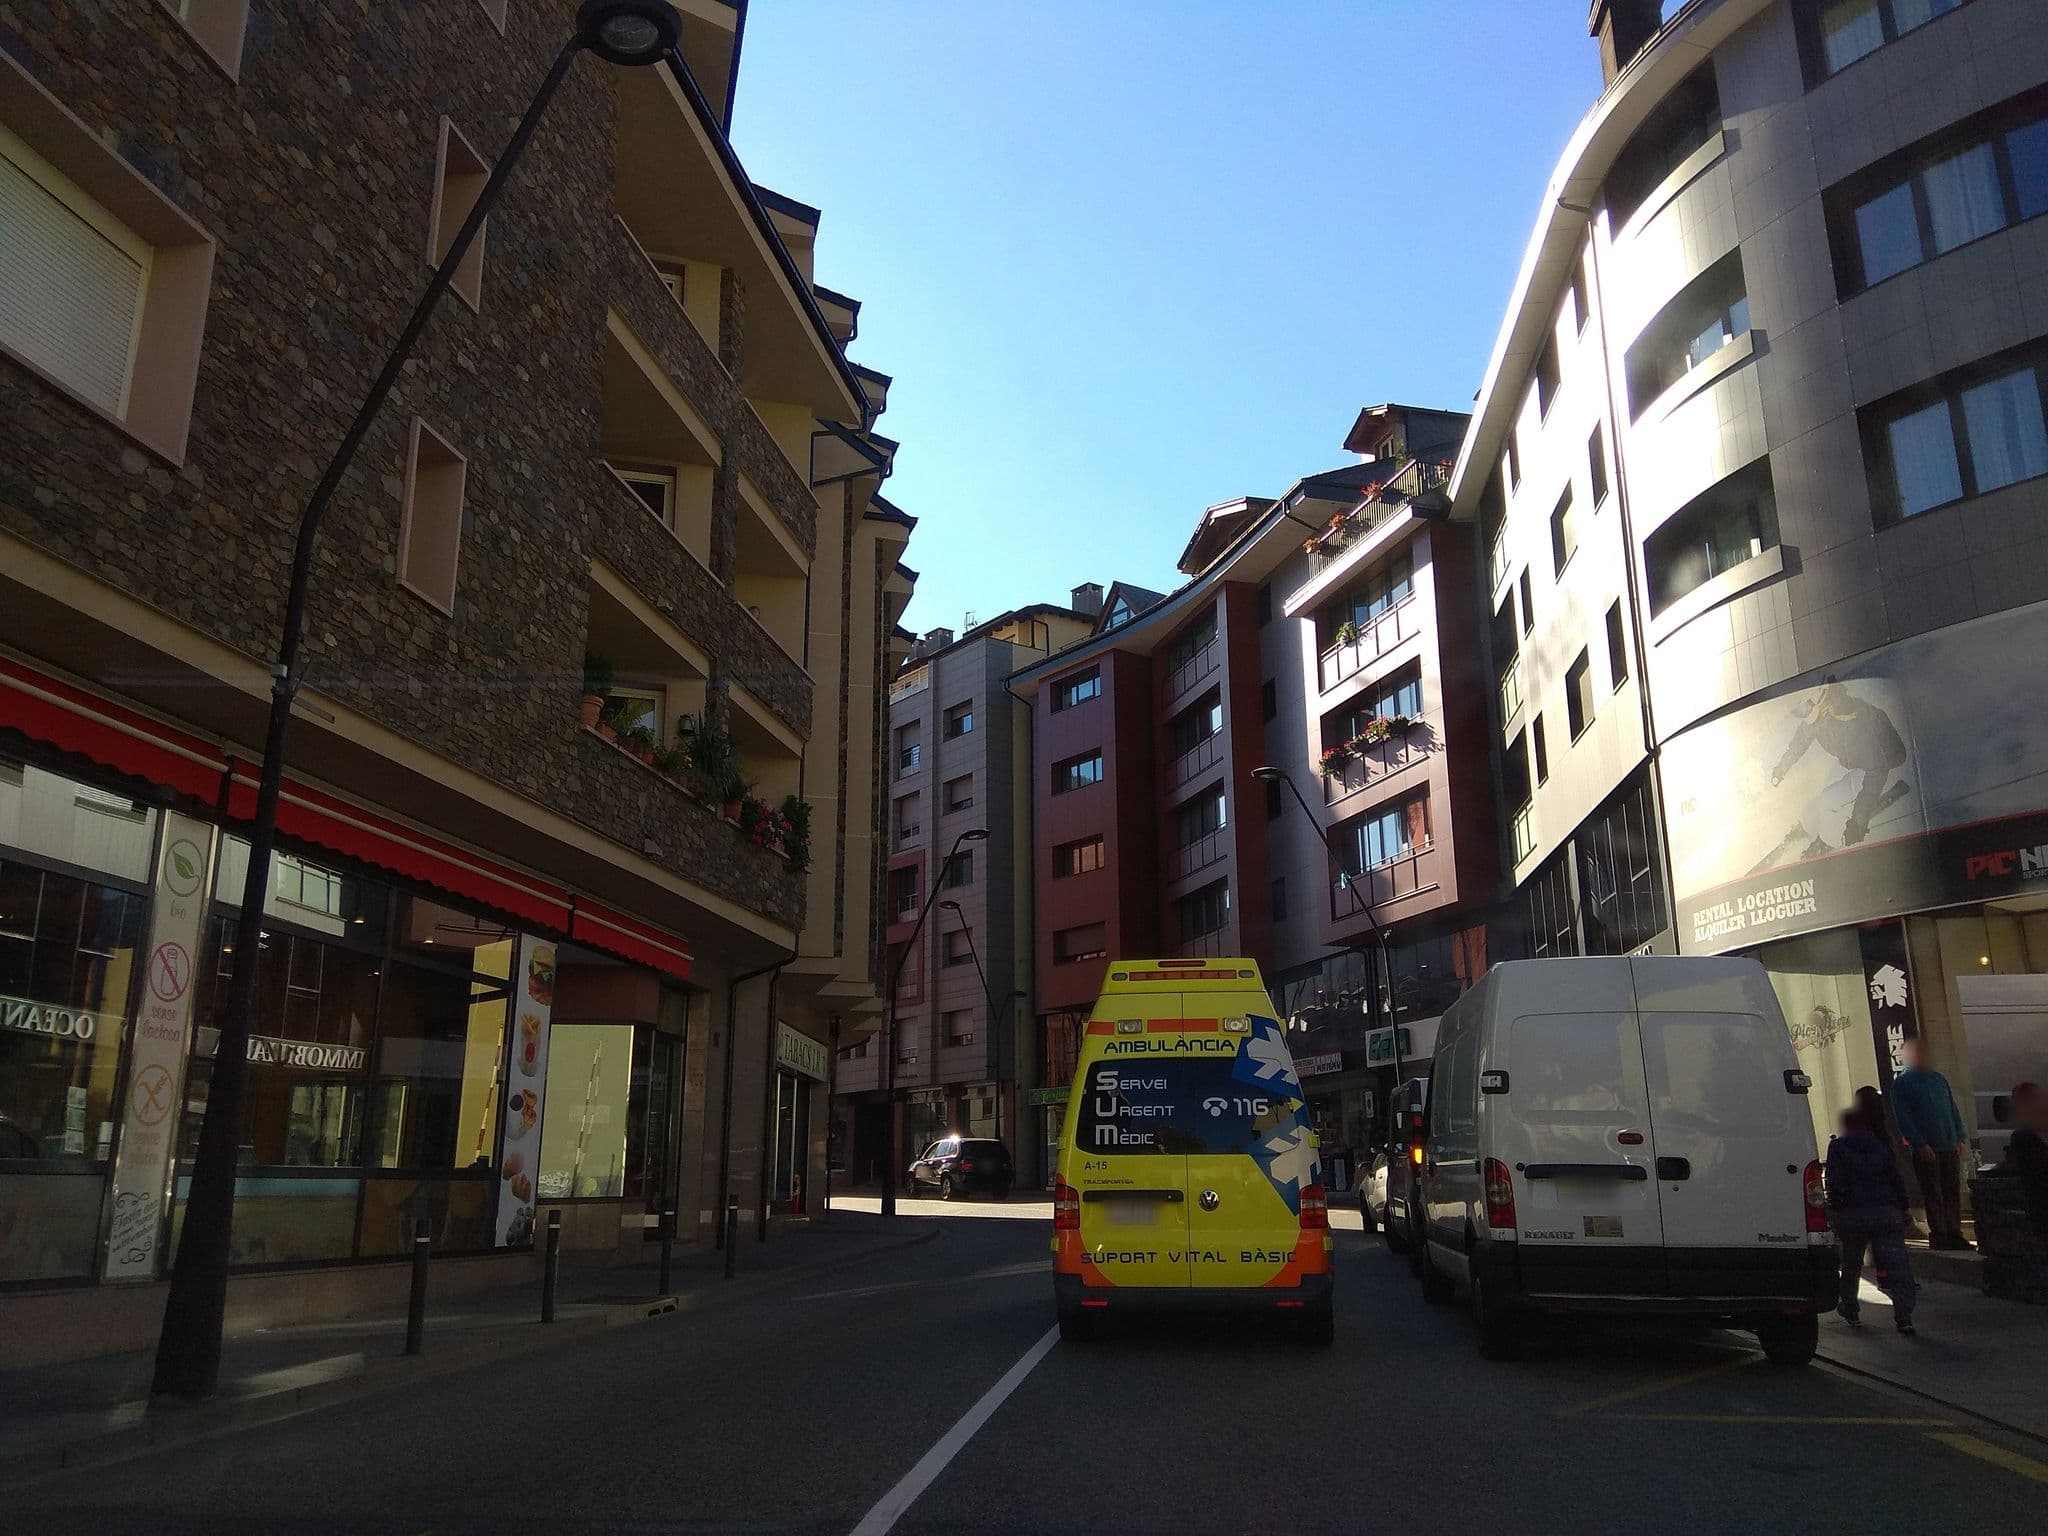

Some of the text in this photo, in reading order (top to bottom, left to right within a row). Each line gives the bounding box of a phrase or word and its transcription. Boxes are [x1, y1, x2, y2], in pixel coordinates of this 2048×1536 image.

[1693, 879, 1815, 927] RENTAL LOCATION
[1695, 897, 1817, 943] ALQUILER LLOGUER
[1104, 1035, 1236, 1054] AMBULÀNCIA
[1233, 1098, 1270, 1116] 116
[1084, 1161, 1108, 1170] A-15
[1524, 1231, 1576, 1240] RENAULT
[1081, 1248, 1297, 1264] SUPORT VITAL BÀSIC
